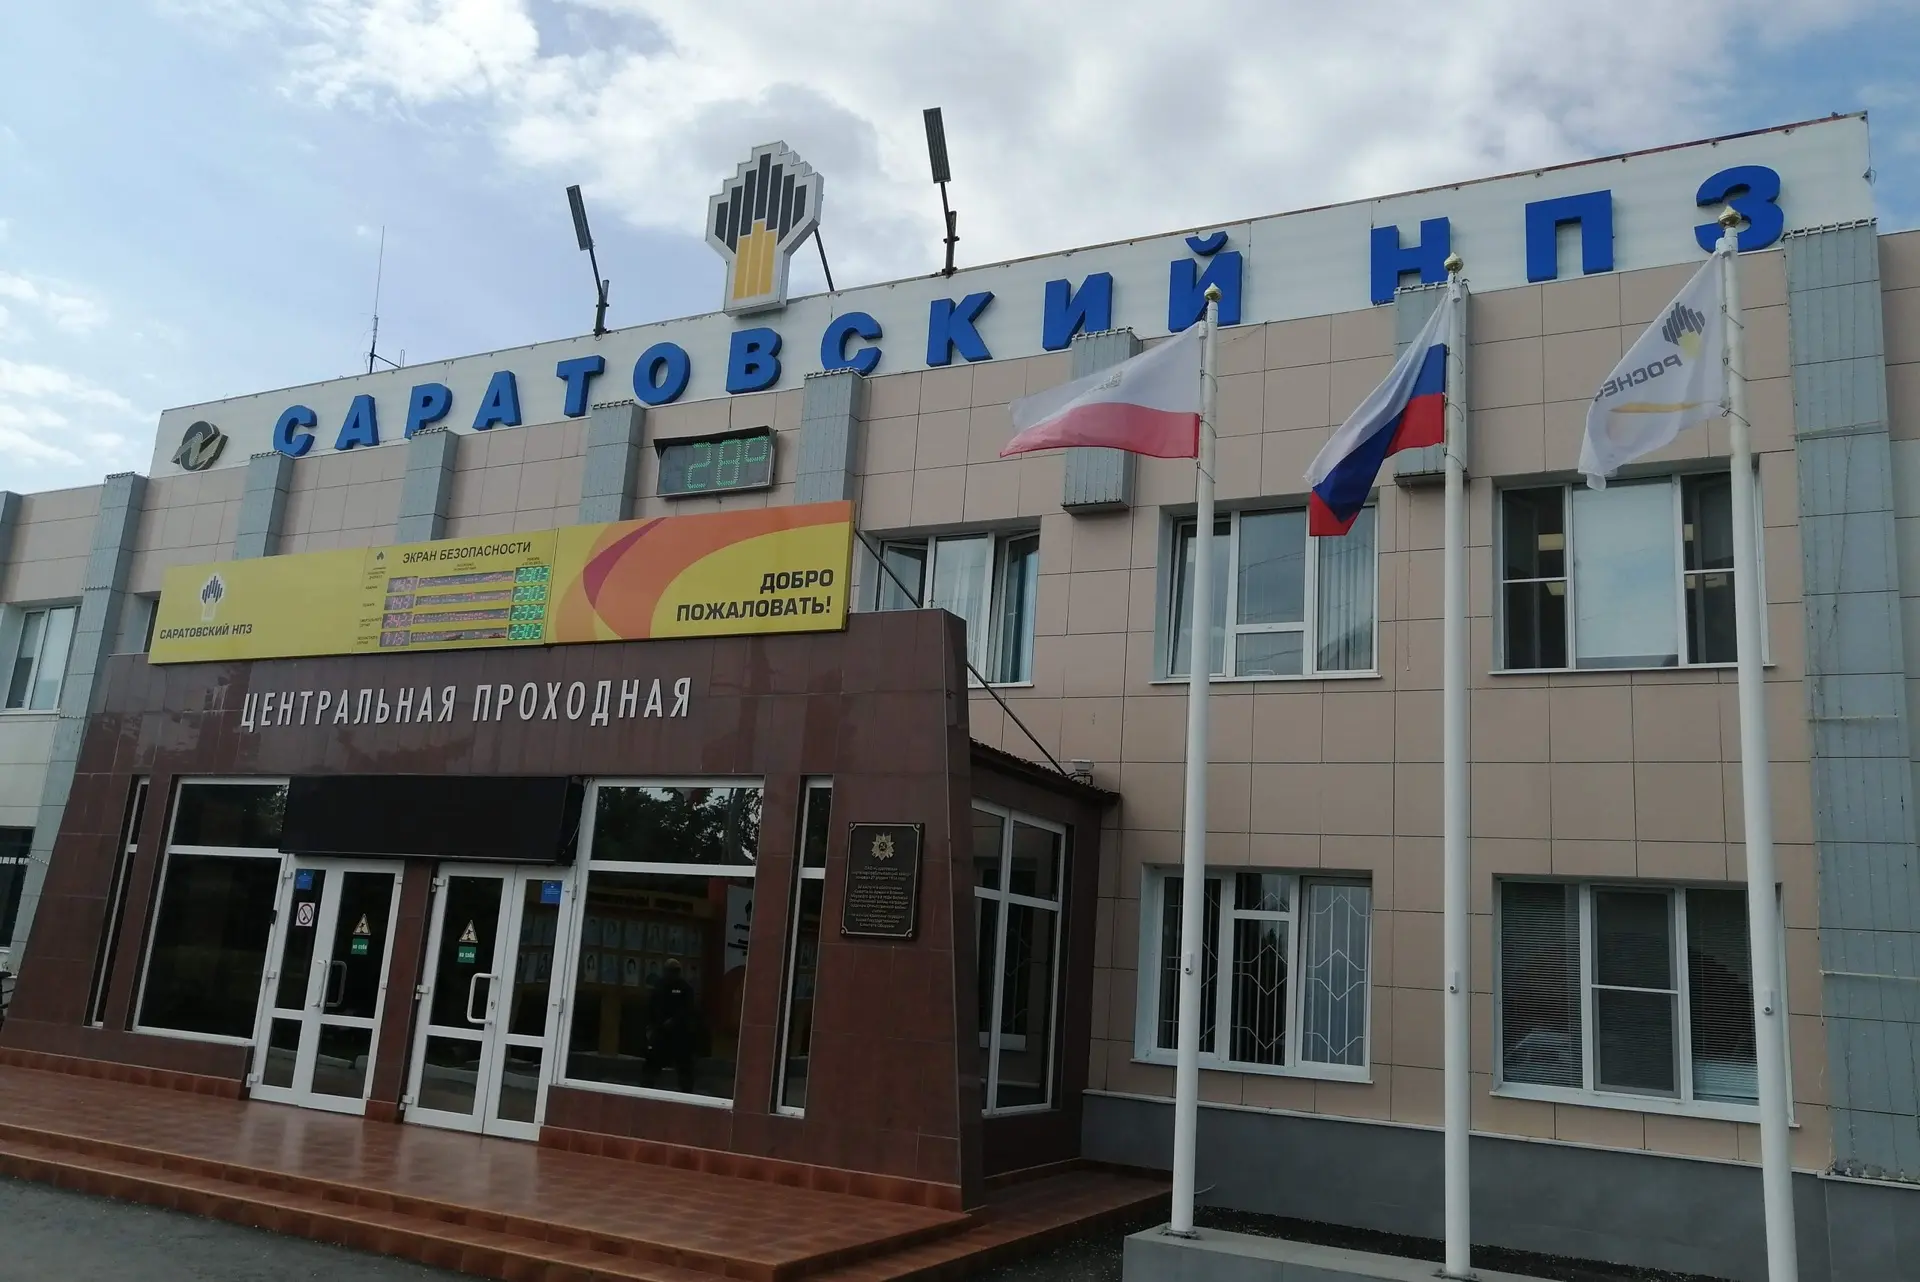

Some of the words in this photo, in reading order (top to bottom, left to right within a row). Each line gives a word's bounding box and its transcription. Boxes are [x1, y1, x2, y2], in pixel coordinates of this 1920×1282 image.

[272, 231, 1243, 457] САРАТОВСКИЙ
[1370, 165, 1784, 305] НПЗ
[403, 549, 437, 564] ЭКРАН
[440, 541, 532, 561] БЕЗОПАСНОСТИ
[760, 568, 834, 594] ДОБРО
[676, 596, 832, 622] ПОЖАЛОВАТЬ!
[160, 623, 229, 640] САРАТОВСКИЙ
[231, 622, 253, 635] НПЗ
[241, 685, 457, 733] ЦЕНТРАЛЬНАЯ
[472, 677, 692, 727] ПРОХОДНАЯ
